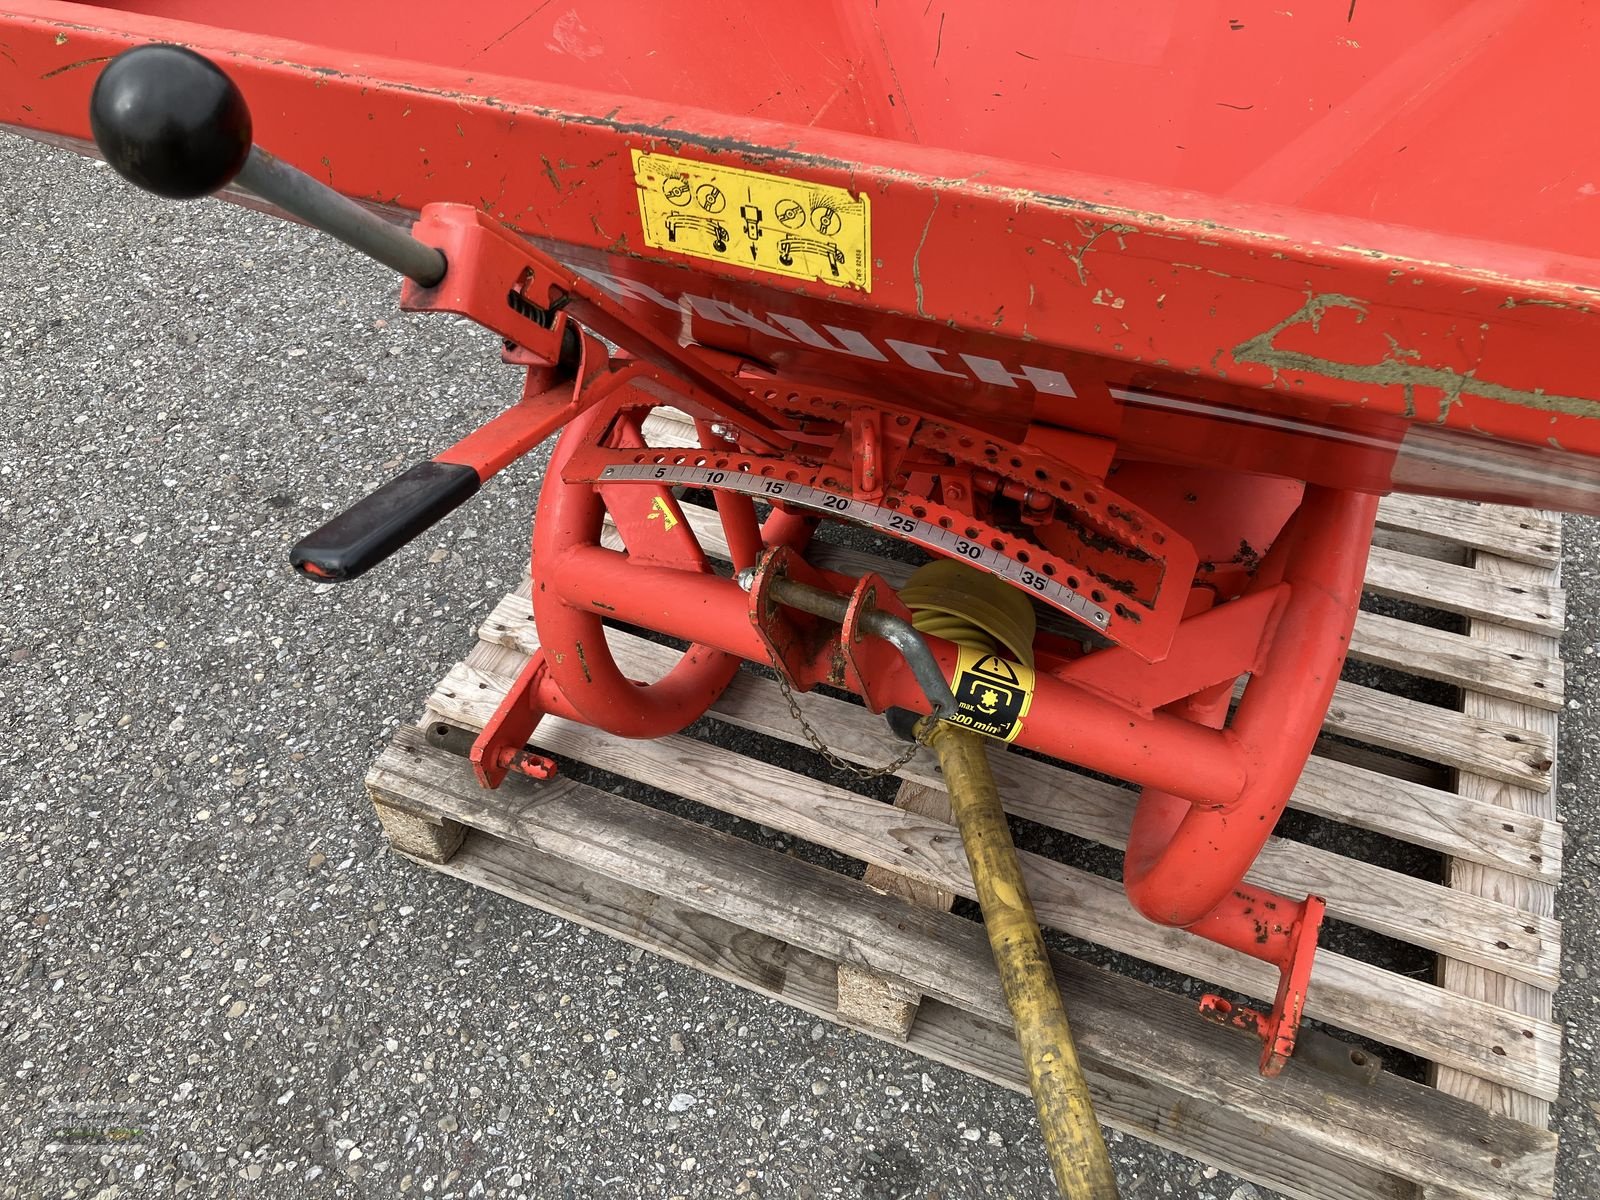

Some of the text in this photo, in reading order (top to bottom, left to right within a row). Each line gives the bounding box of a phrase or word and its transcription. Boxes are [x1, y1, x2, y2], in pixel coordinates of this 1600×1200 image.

[654, 467, 1047, 591] 5 10 15 20 25 30 35
